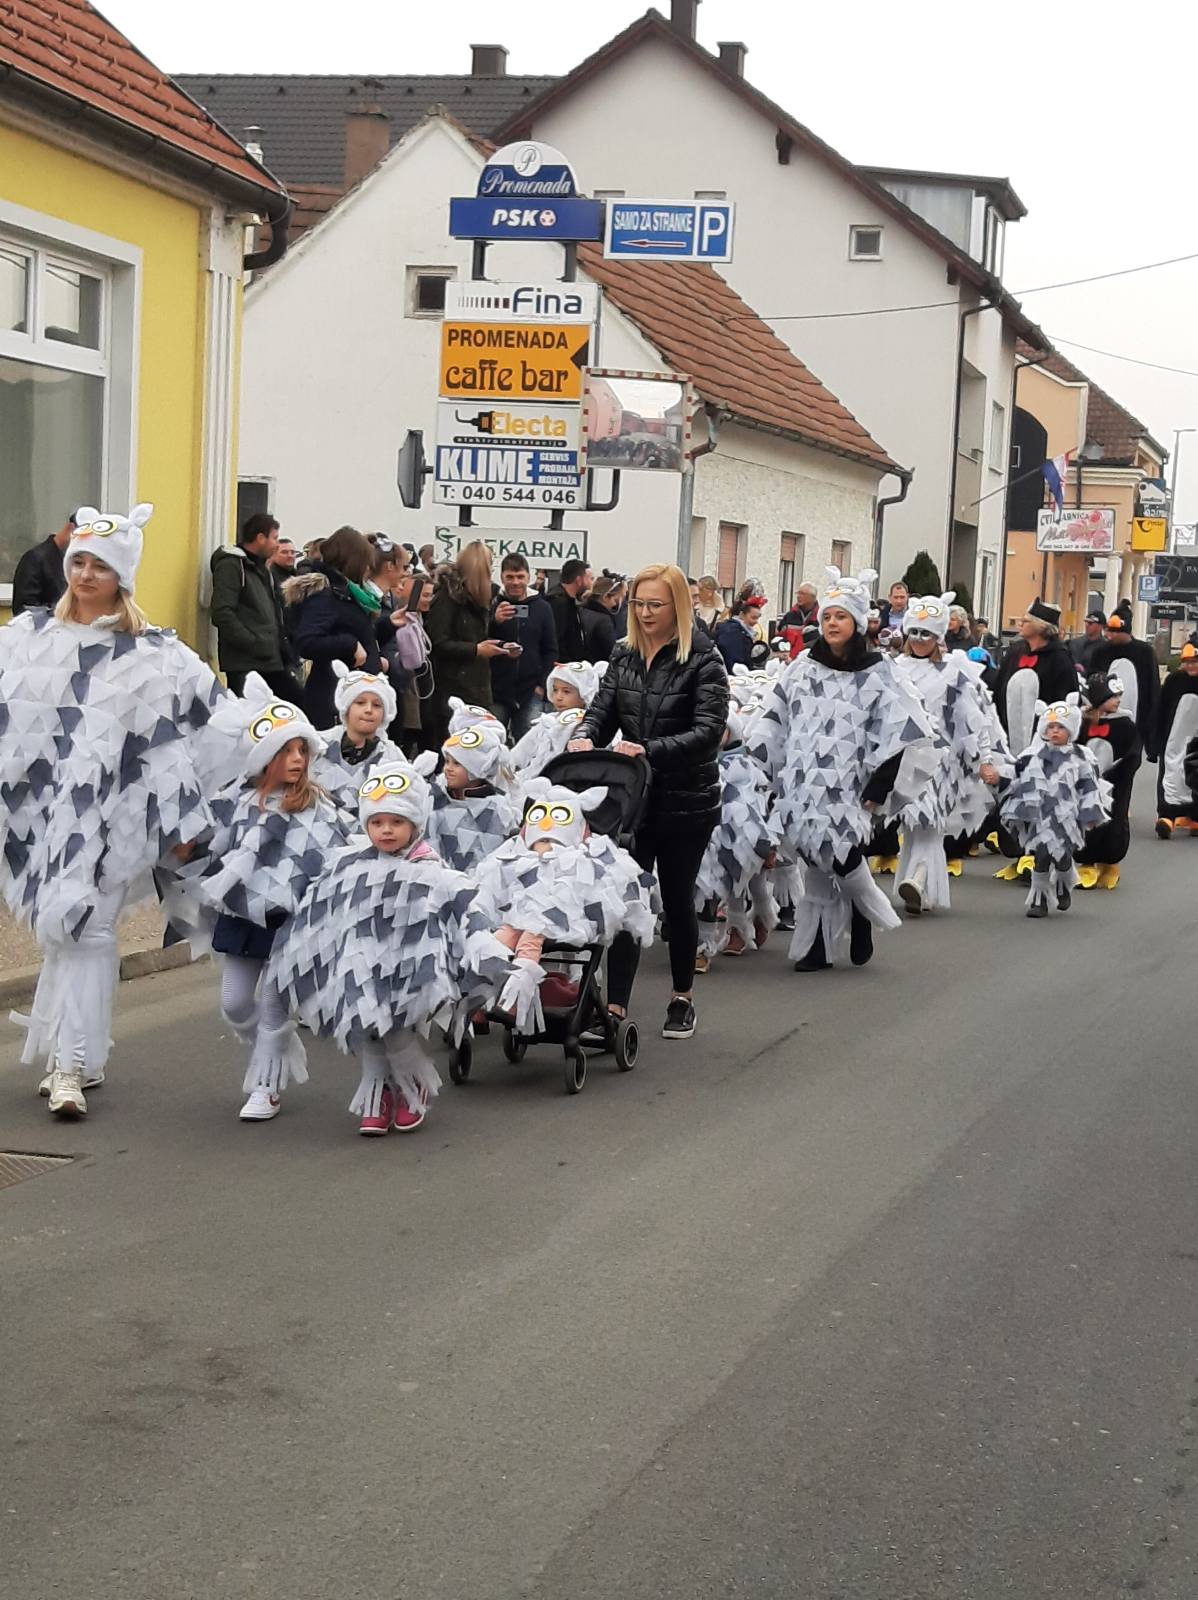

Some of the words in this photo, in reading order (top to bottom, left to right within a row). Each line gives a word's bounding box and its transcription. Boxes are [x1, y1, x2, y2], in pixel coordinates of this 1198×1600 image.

[482, 168, 571, 195] Promenada
[492, 208, 538, 227] PSK
[614, 210, 640, 231] SAMO
[640, 212, 653, 232] ZA
[653, 212, 693, 232] STRANKE
[702, 211, 725, 251] P
[513, 287, 582, 314] Fina
[447, 329, 568, 349] PROMENADA
[445, 359, 513, 392] caffe
[521, 360, 568, 392] bar
[491, 411, 567, 436] Electa
[440, 448, 533, 483] KLIME
[440, 484, 456, 499] T:
[462, 485, 496, 501] 040
[502, 488, 536, 502] 544
[542, 489, 576, 504] 046
[457, 538, 581, 559] LEKARNA
